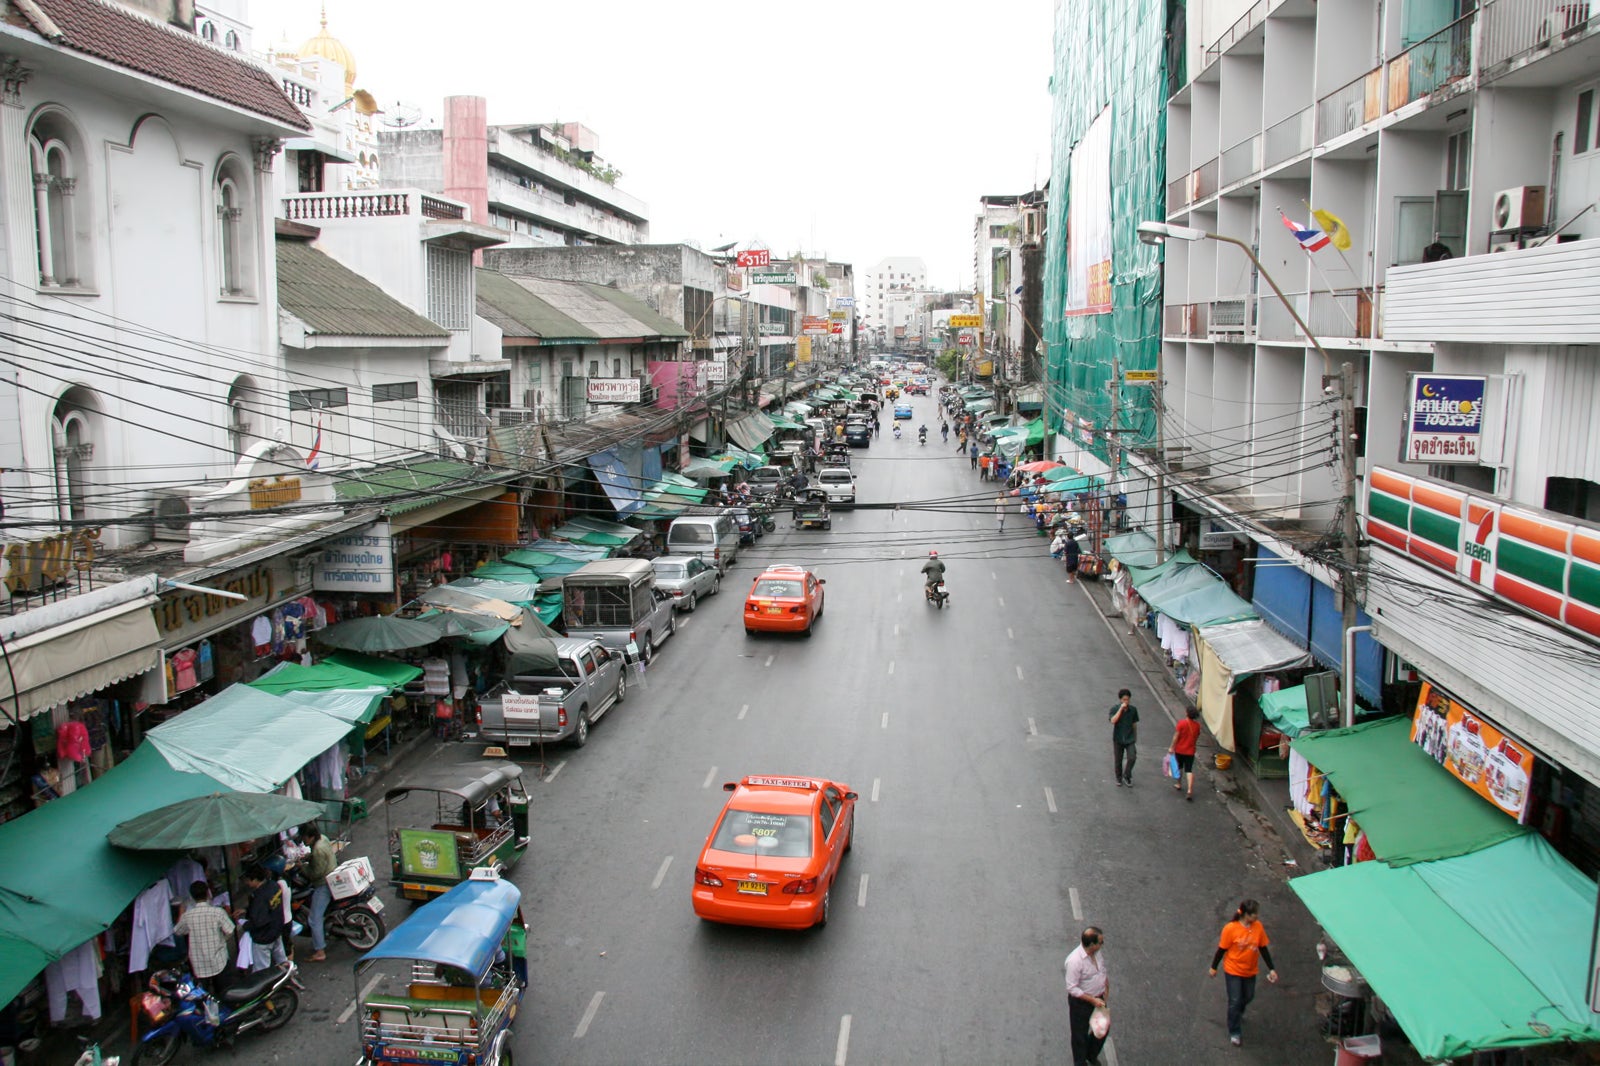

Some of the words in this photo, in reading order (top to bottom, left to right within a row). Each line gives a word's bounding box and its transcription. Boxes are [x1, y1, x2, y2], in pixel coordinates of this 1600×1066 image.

[1413, 435, 1476, 460] จุดชำระเงิน
[1467, 503, 1494, 585] 7
[762, 779, 807, 787] TAXI-METER
[752, 828, 776, 836] 5807
[751, 881, 766, 890] 9215
